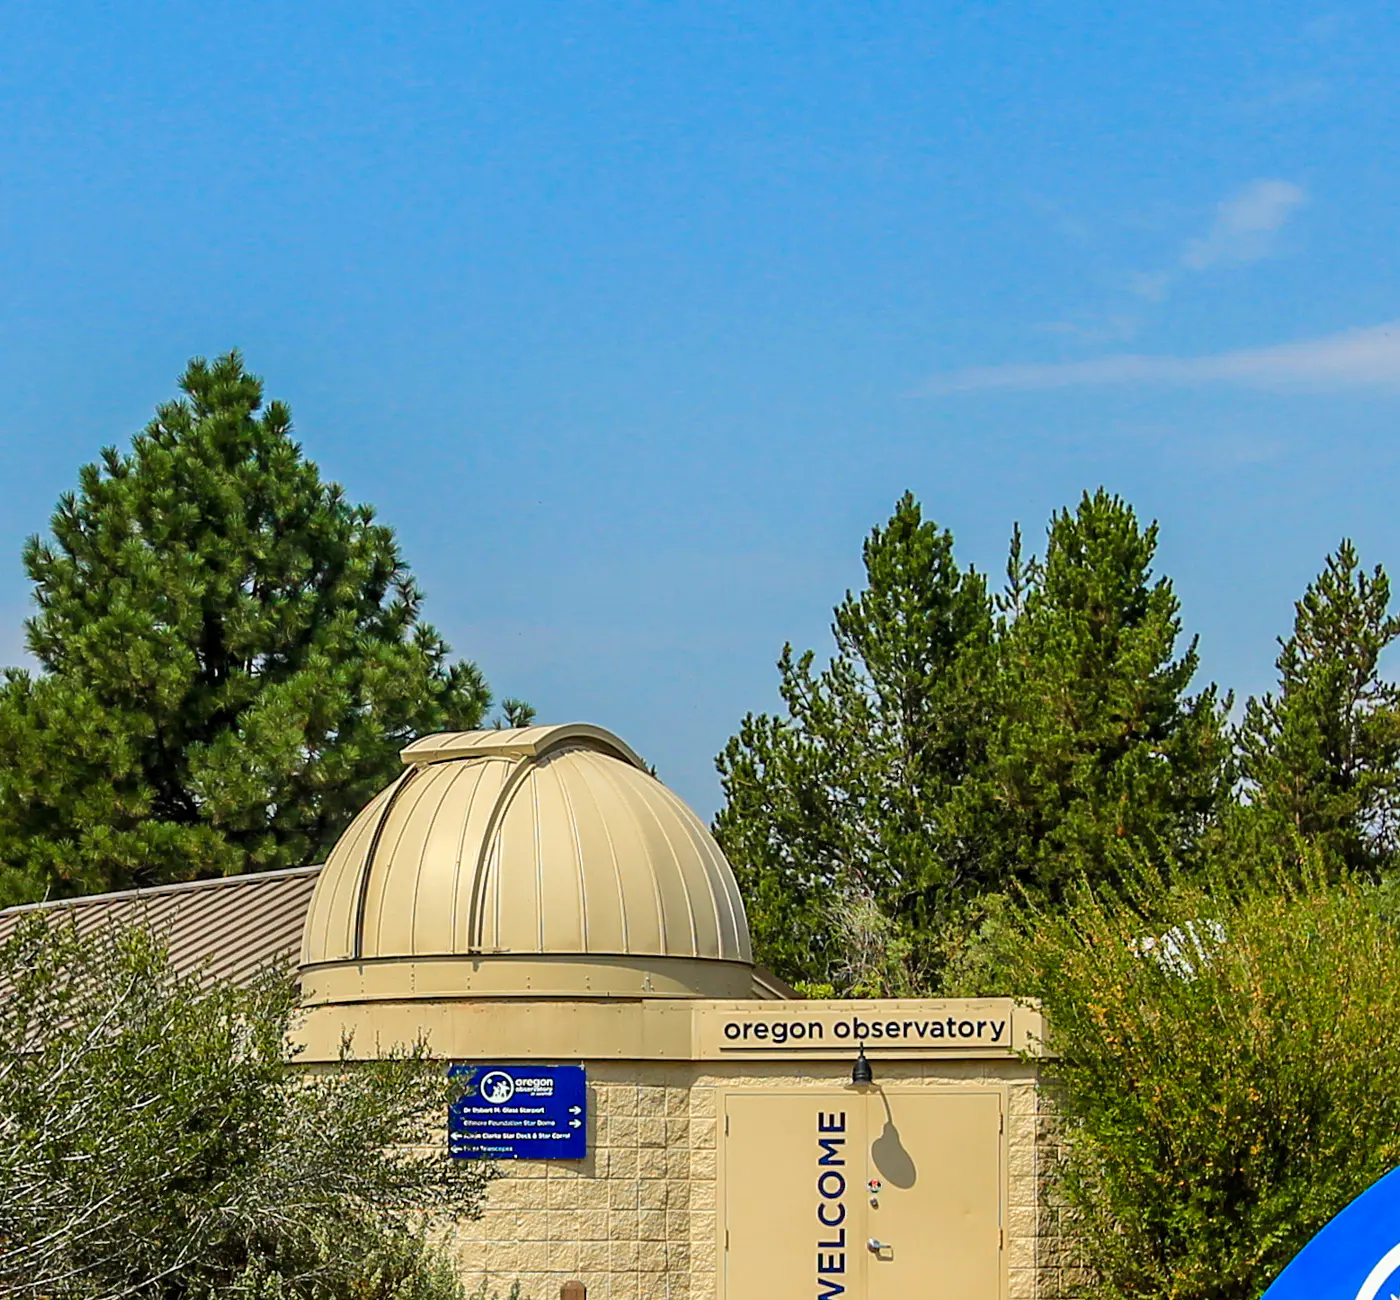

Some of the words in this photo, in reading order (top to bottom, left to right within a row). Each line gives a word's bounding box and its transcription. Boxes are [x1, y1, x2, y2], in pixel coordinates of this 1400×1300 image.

[724, 1021, 823, 1043] oregon
[833, 1017, 1005, 1042] observatory
[515, 1078, 554, 1089] oregon
[488, 1119, 522, 1127] Foundation
[523, 1119, 536, 1127] Star
[537, 1119, 556, 1127] Dome
